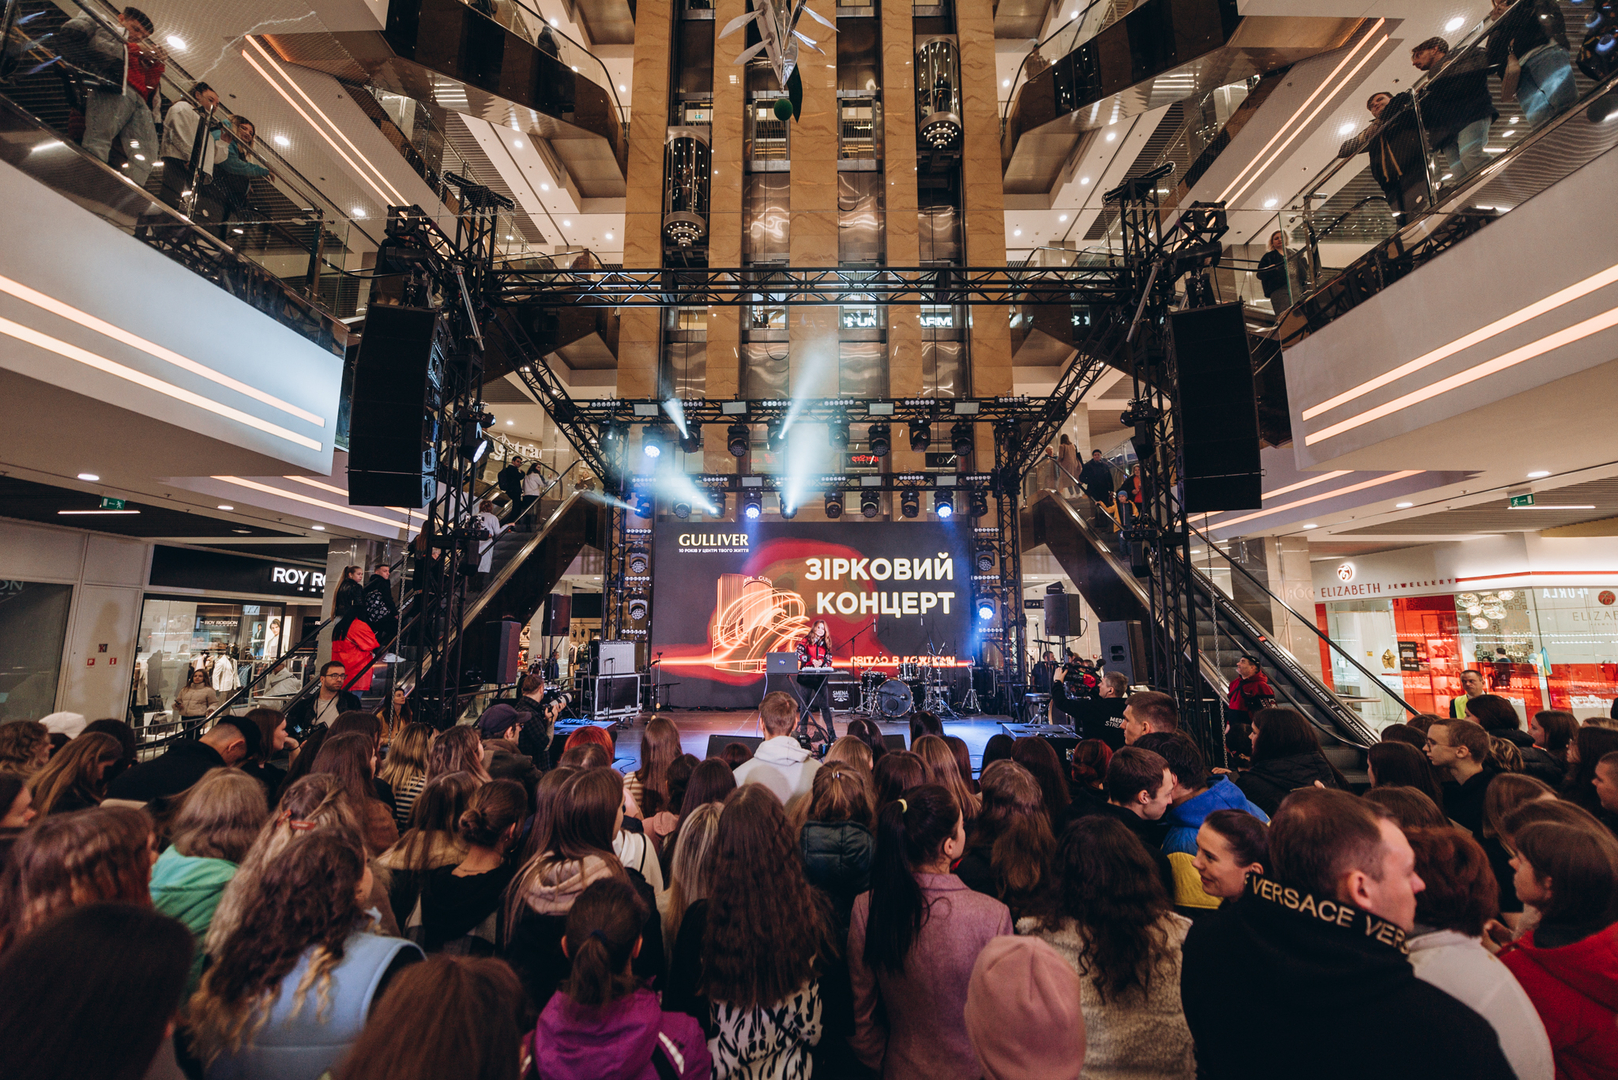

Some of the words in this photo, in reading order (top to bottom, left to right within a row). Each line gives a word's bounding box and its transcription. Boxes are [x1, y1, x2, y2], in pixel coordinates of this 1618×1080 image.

[678, 534, 748, 546] GULLIVER
[273, 567, 309, 584] ROY
[804, 552, 954, 580] ЗІРКОВИЙ
[1321, 583, 1380, 597] ELIZABETH
[1388, 578, 1452, 589] JEWELLERY
[816, 592, 956, 618] КОНЦЕРТ
[1252, 874, 1356, 928] VERSACE
